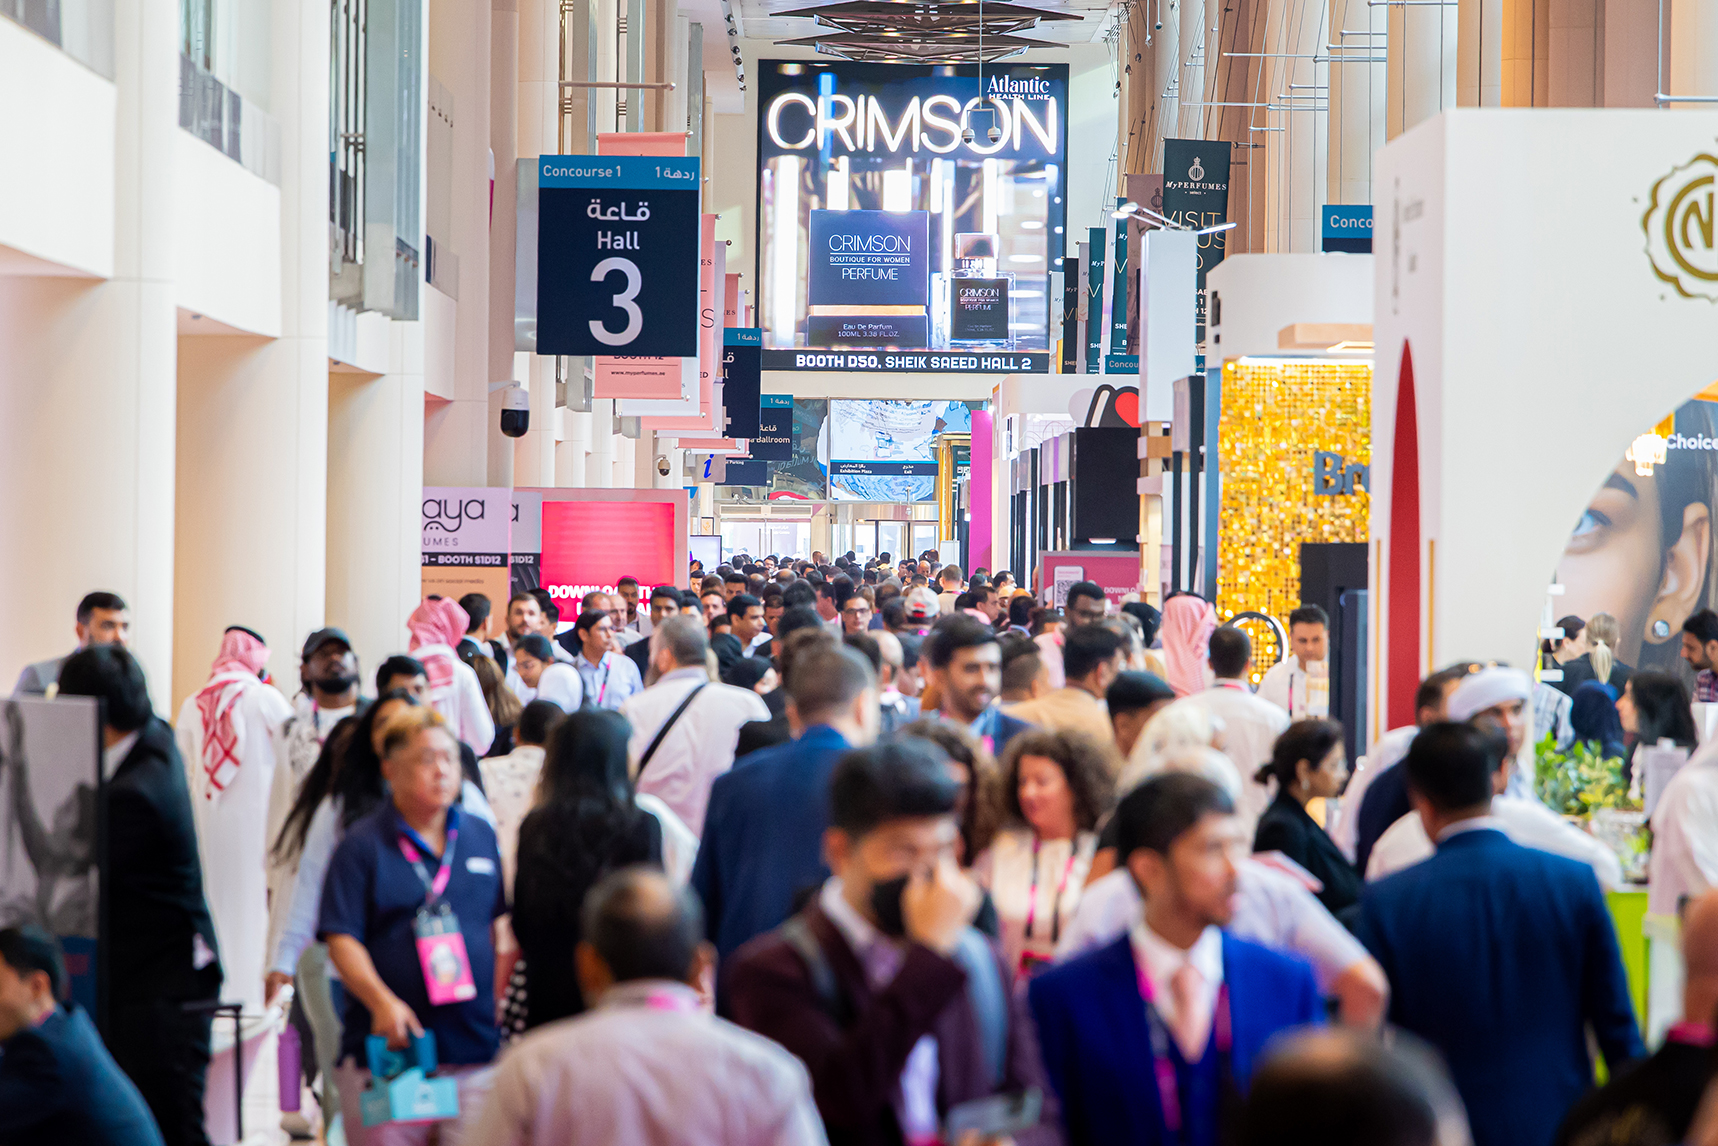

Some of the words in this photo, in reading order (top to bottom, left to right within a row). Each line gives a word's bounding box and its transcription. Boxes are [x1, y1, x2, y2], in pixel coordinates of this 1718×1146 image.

[987, 75, 1050, 93] Atlantic
[767, 92, 1058, 155] CRIMSON
[543, 165, 613, 177] Concourse
[616, 165, 622, 177] 1
[655, 166, 661, 178] 1
[663, 168, 695, 181] ردهة
[1165, 181, 1227, 191] MyPERFUMES
[587, 199, 651, 221] قاعة
[1162, 210, 1221, 230] VISIT
[597, 231, 640, 250] Hall
[829, 234, 911, 252] CRIMSON
[883, 256, 911, 264] WOMEN
[842, 267, 898, 281] PERFUME
[960, 288, 999, 297] CRIMSON
[588, 257, 643, 346] 3
[796, 354, 845, 368] BOOTH
[847, 355, 882, 369] D50,
[885, 356, 927, 369] SHEIK
[930, 357, 978, 369] SAEED
[981, 357, 1019, 370] HALL
[1021, 358, 1032, 370] 2
[438, 555, 473, 565] BOOTH
[474, 555, 501, 565] S1D12
